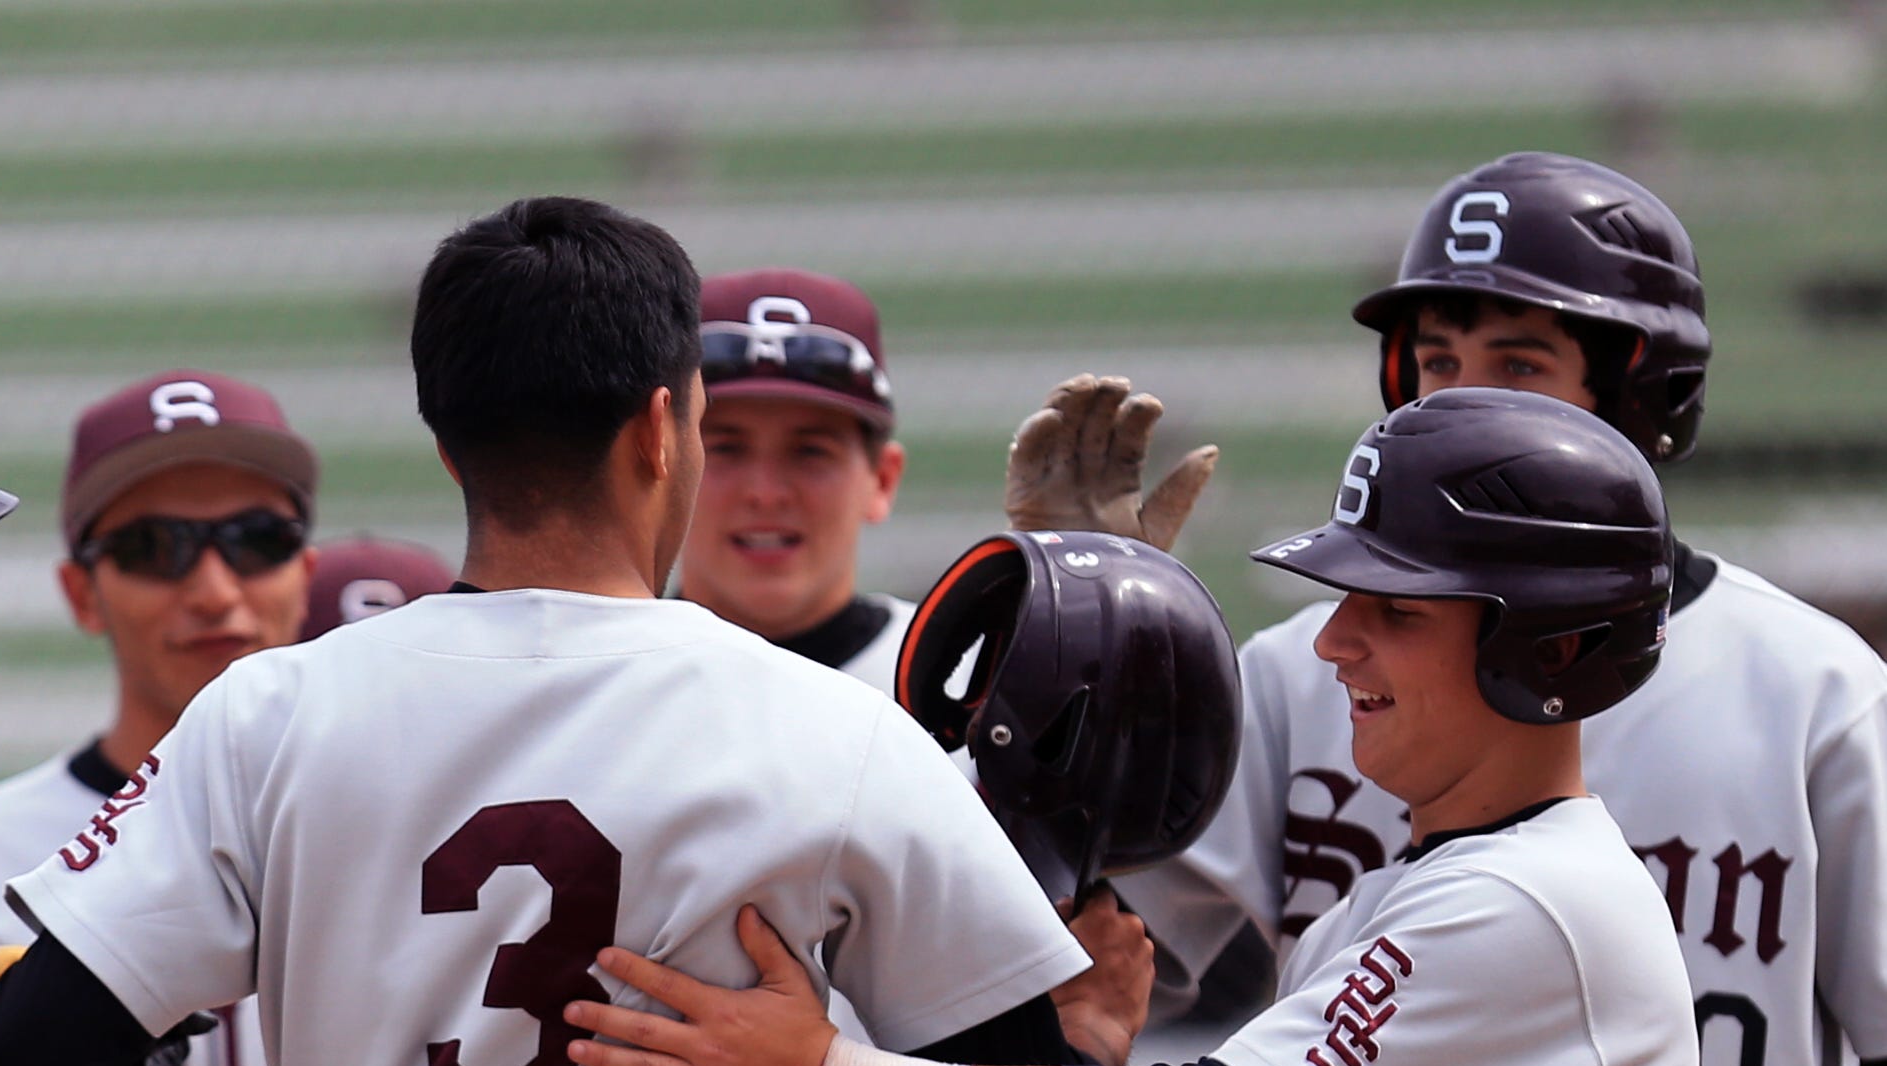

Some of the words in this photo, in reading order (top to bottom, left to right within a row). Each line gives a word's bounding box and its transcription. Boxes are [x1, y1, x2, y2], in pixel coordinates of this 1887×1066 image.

[1444, 190, 1510, 265] S
[150, 380, 221, 433] S
[1335, 443, 1381, 526] S
[1064, 551, 1100, 568] 3
[1269, 537, 1314, 560] 2
